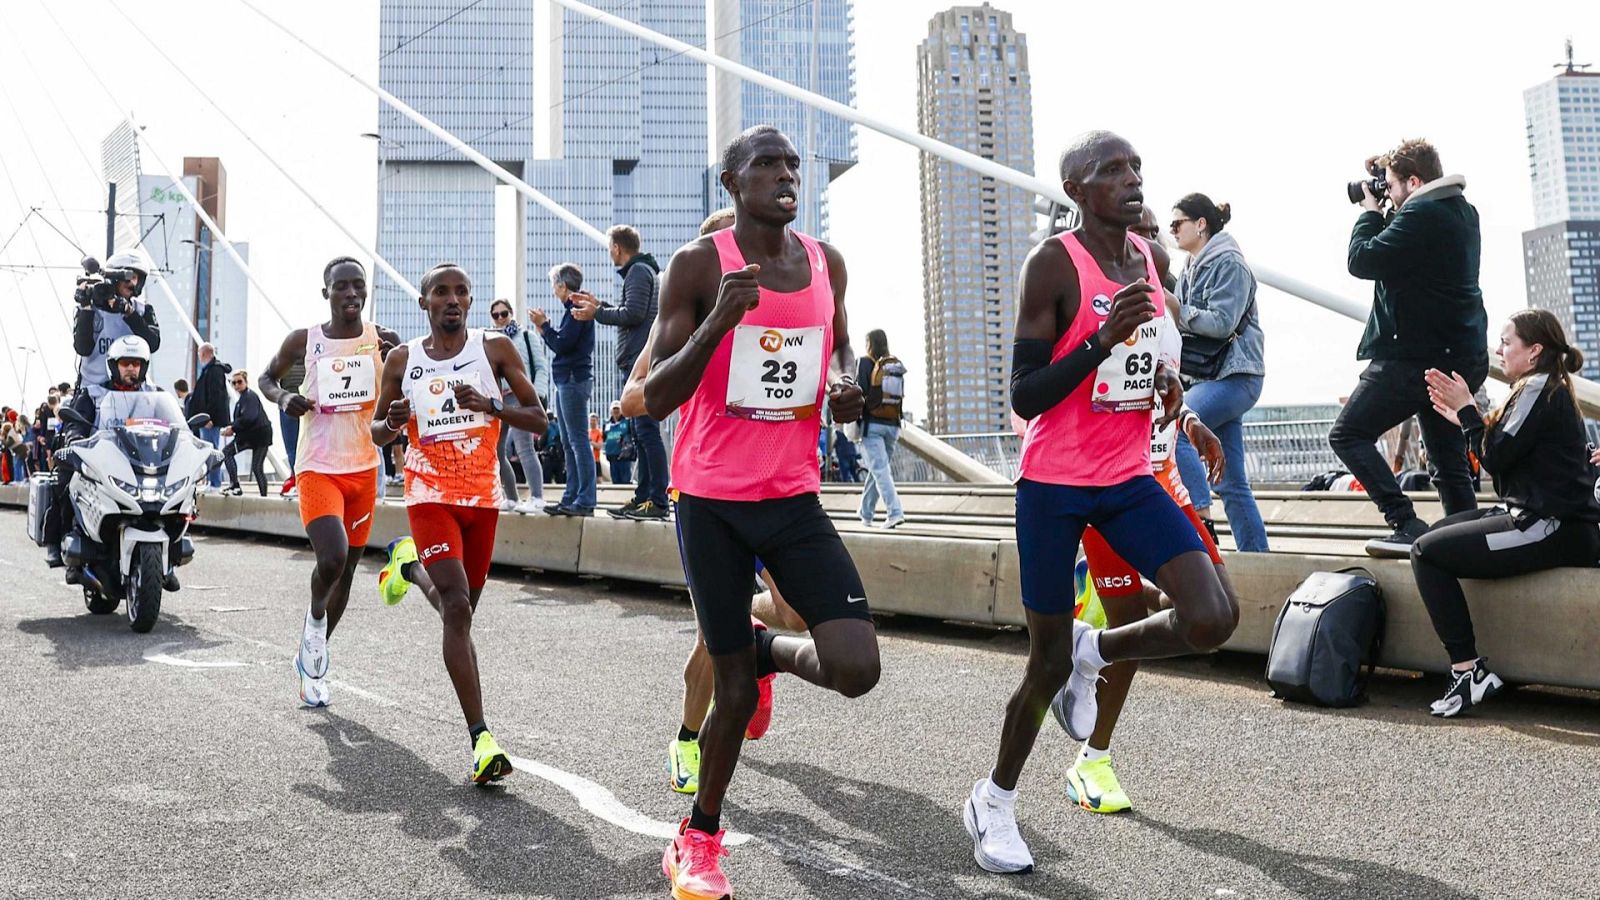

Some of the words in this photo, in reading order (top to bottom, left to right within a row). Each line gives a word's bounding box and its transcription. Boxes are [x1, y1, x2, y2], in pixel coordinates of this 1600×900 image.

[1141, 327, 1157, 339] NN
[784, 336, 803, 347] NN
[1125, 352, 1152, 376] 63
[761, 359, 797, 384] 23
[341, 376, 351, 390] 7
[1124, 378, 1152, 390] PACE
[328, 390, 368, 400] ONCHARI
[765, 387, 794, 399] TOO
[441, 398, 455, 414] 4
[427, 414, 475, 428] NAGEEYE
[1151, 444, 1167, 453] ESE
[1096, 575, 1132, 588] INEOS
